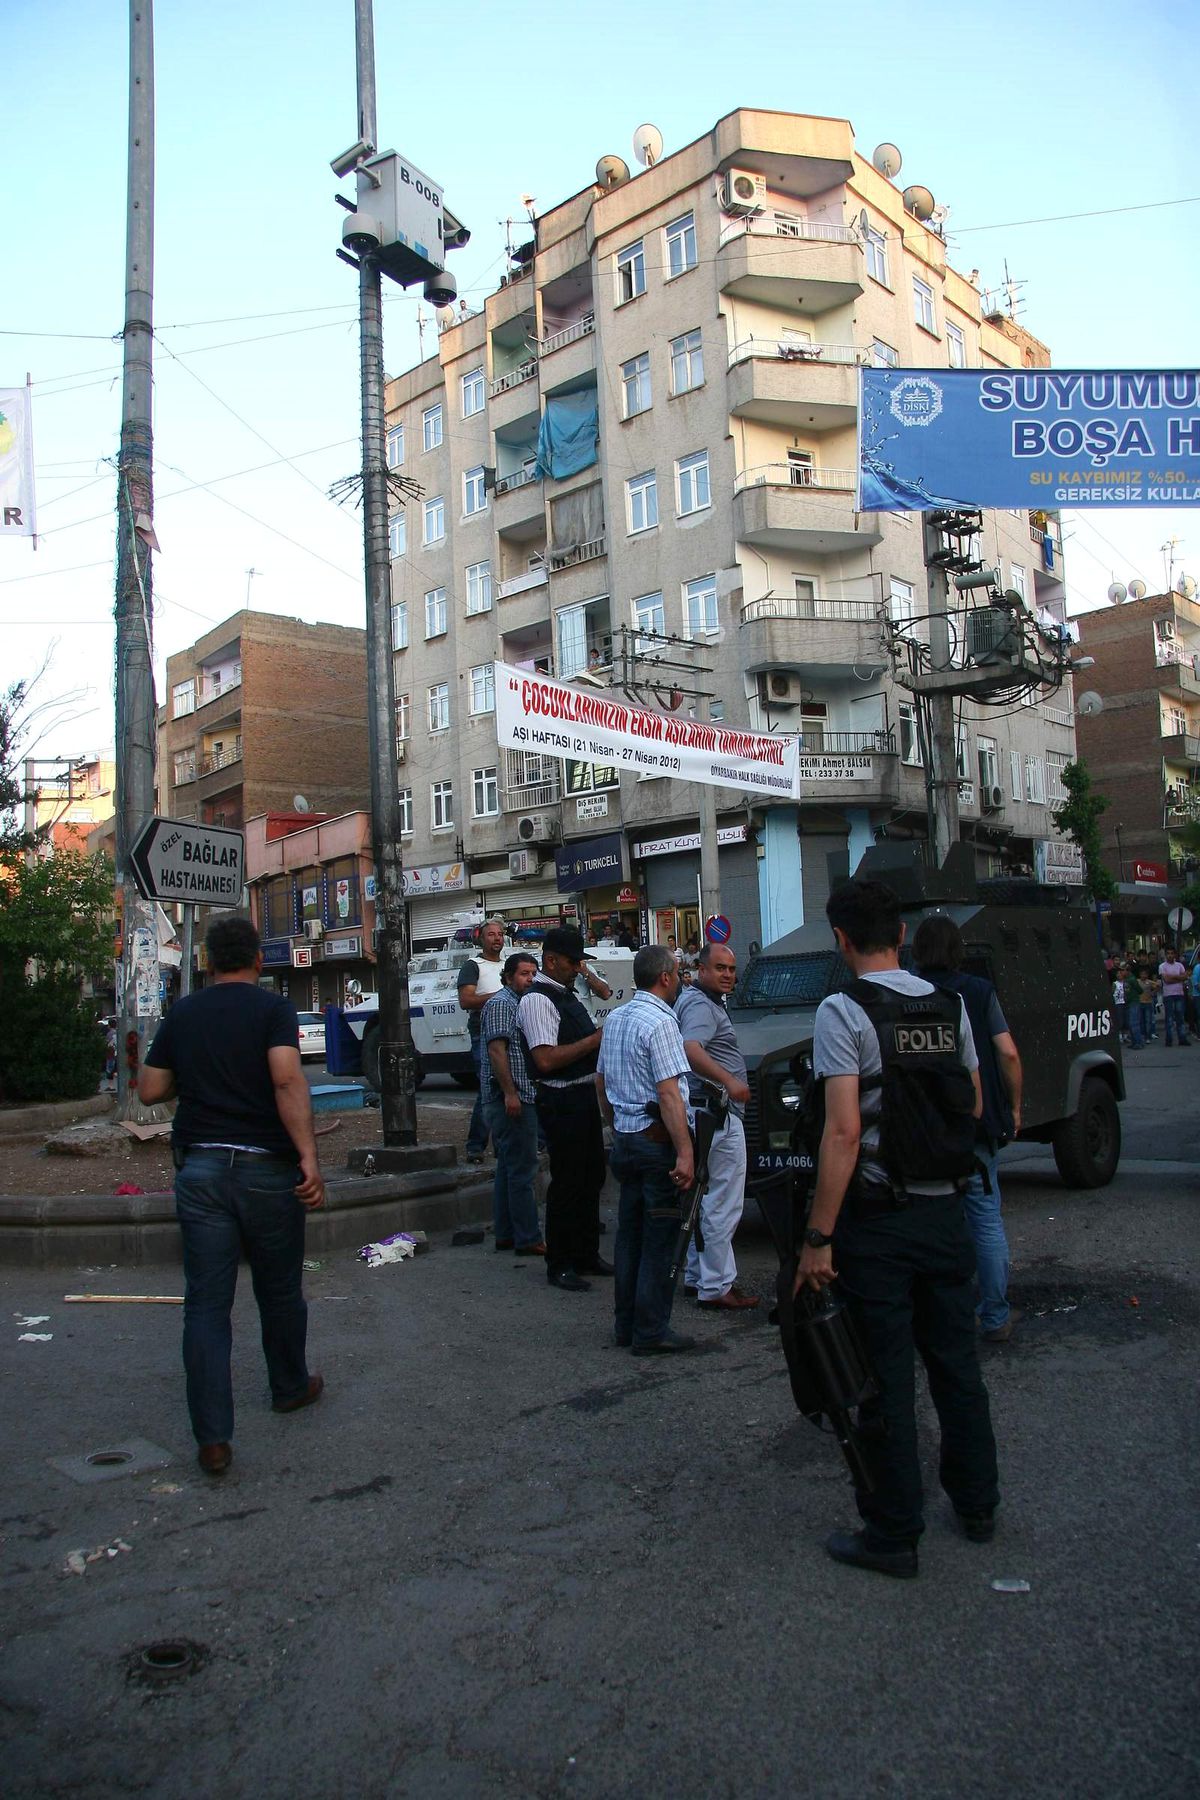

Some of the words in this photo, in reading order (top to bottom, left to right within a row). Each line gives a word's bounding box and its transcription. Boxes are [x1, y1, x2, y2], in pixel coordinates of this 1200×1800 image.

[400, 166, 440, 207] B-008
[979, 372, 1200, 412] SUYUMU
[1012, 419, 1155, 467] BOŞA
[1029, 472, 1053, 485] SU
[1058, 472, 1142, 485] KAYBIMIZ
[1054, 486, 1142, 501] GEREKSİZ
[3, 507, 24, 526] R
[522, 680, 628, 733] ÇOCUKLARINIZIN
[629, 708, 662, 741] EKSİK
[664, 717, 716, 752] AŞILARINI
[512, 726, 529, 743] AŞI
[532, 730, 571, 749] HAFTASI
[573, 740, 587, 753] (21
[590, 741, 614, 757] Nisan
[622, 748, 633, 760] 27
[635, 750, 657, 766] Nisan
[660, 755, 681, 773] 2012)
[799, 757, 821, 768] EKiMi
[822, 758, 845, 768] Ahmet
[739, 771, 750, 782] HALK
[160, 831, 183, 853] ÖZEL
[643, 841, 672, 855] FIRAT
[182, 839, 239, 868] BAĞLAR
[584, 854, 619, 871] TURKCELL
[160, 868, 237, 894] HASTAHANESİ
[897, 1026, 954, 1051] POLİS
[758, 1155, 771, 1168] 21
[775, 1156, 783, 1168] A
